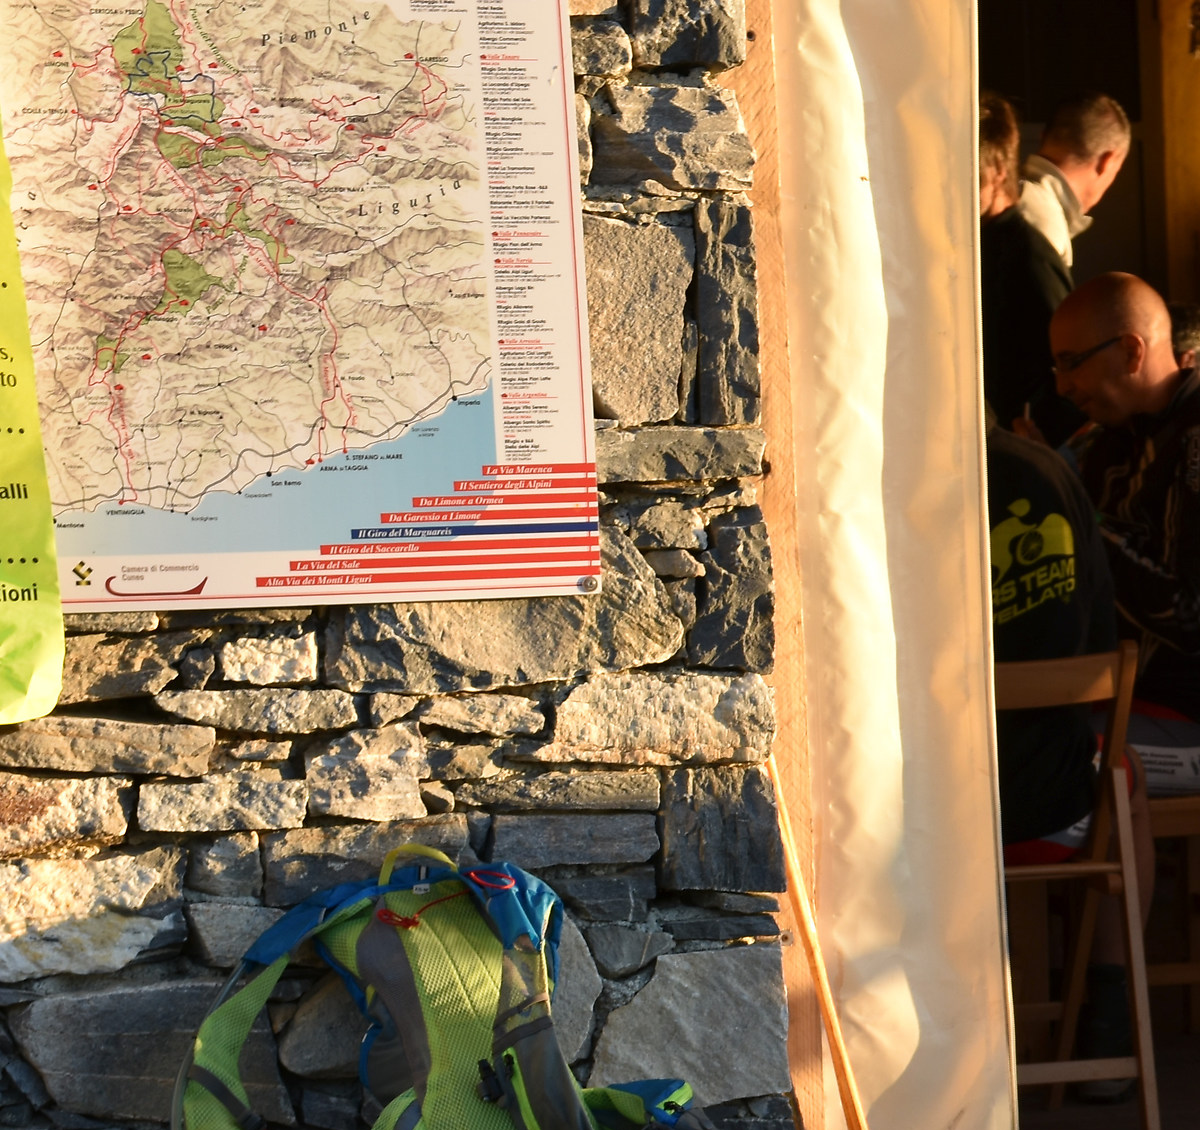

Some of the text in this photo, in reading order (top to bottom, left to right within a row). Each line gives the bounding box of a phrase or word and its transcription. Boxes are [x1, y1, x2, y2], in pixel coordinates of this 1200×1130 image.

[261, 9, 371, 47] Piemonte
[358, 179, 462, 217] Liguria
[486, 465, 553, 475] La Via Marenca
[459, 479, 553, 490] Il Sentiero degli Alpini
[420, 498, 433, 506] Da
[434, 497, 466, 506] Limone
[475, 496, 504, 505] Ormea
[105, 508, 146, 516] VENTIMIGLIA
[389, 513, 402, 522] Da
[403, 512, 441, 522] Garessio
[449, 512, 482, 520] Limone
[358, 527, 452, 538] Il Giro del Marguareis
[330, 543, 420, 555] Il Giro del Saccarello
[121, 563, 200, 573] Camera di Commercio
[296, 560, 361, 571] La Via del Sale
[265, 574, 373, 587] Alta Via dei Monti Liguri
[1019, 557, 1075, 593] TEAM
